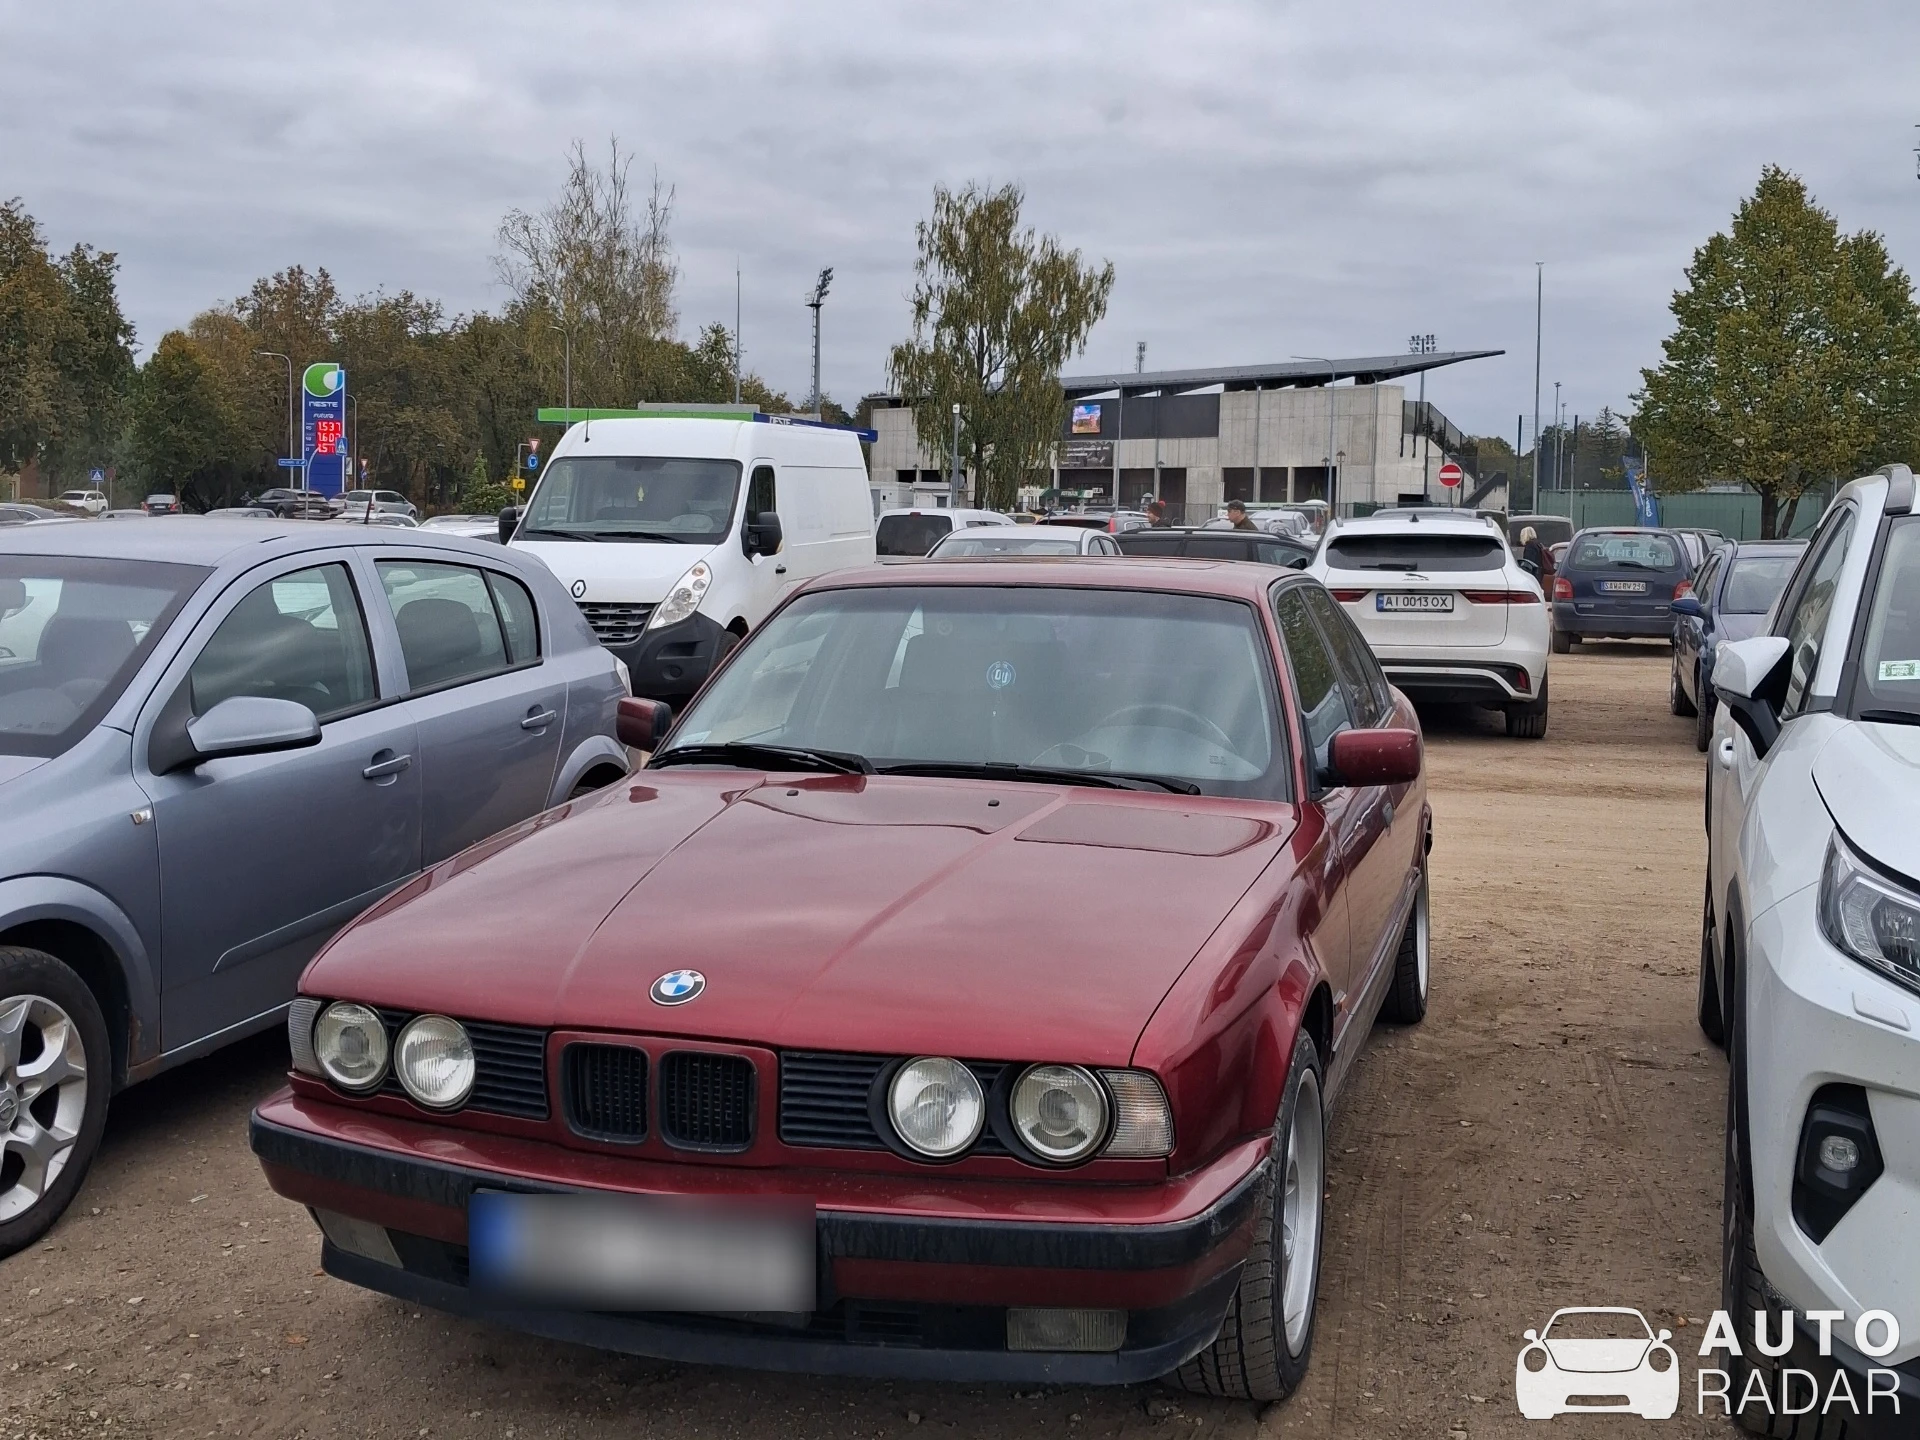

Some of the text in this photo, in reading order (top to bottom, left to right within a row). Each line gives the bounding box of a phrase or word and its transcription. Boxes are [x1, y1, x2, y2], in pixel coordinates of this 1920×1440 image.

[1385, 596, 1448, 607] AI 0013 OX
